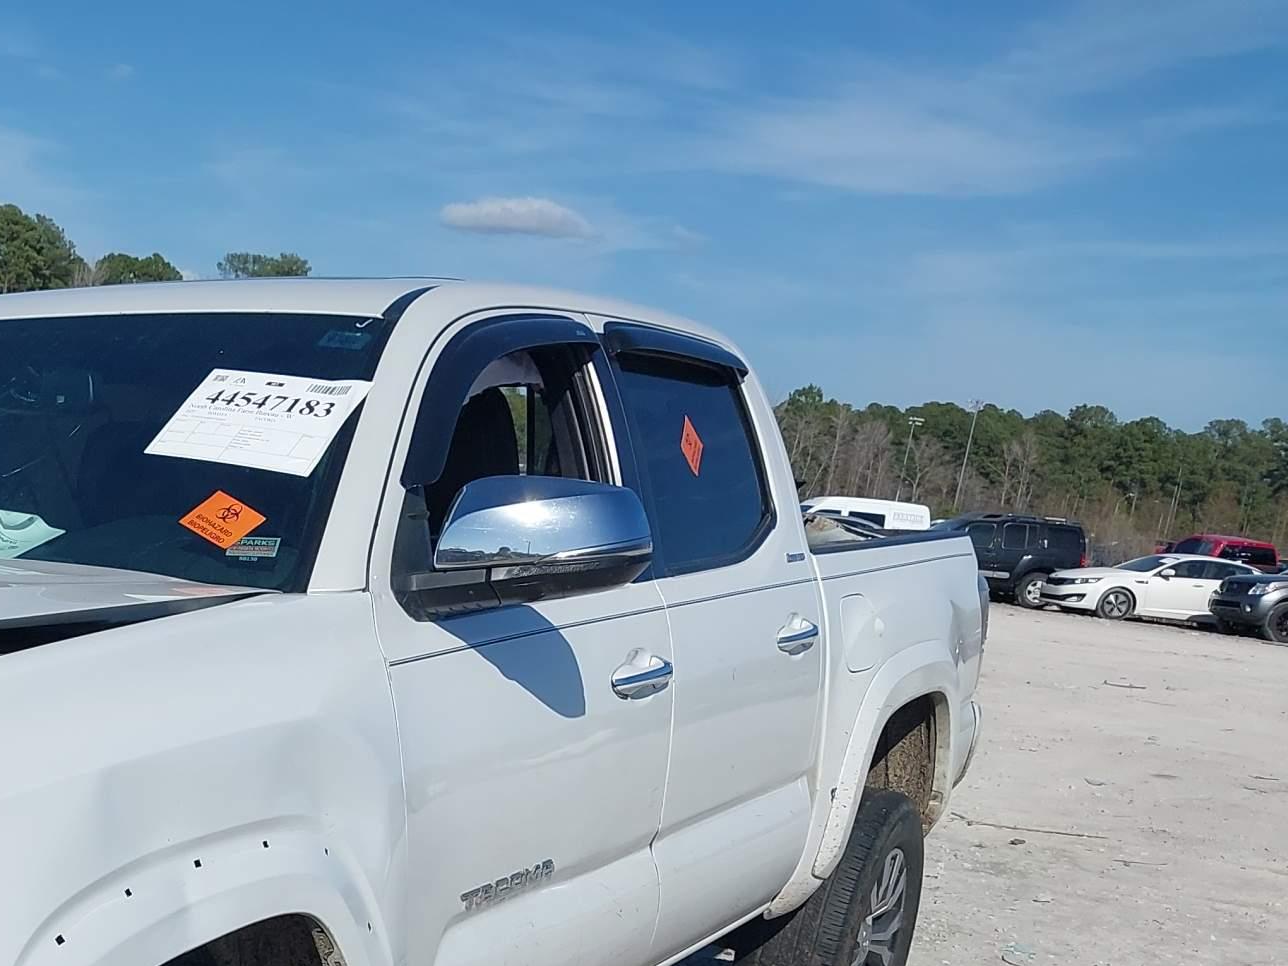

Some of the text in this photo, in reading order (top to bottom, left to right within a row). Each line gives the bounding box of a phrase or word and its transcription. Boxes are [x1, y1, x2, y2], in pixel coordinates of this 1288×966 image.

[205, 389, 336, 418] 44547183
[187, 520, 225, 544] BIOPELIGRO
[196, 513, 233, 538] BIOHAZARD
[460, 858, 555, 911] TACOMA
